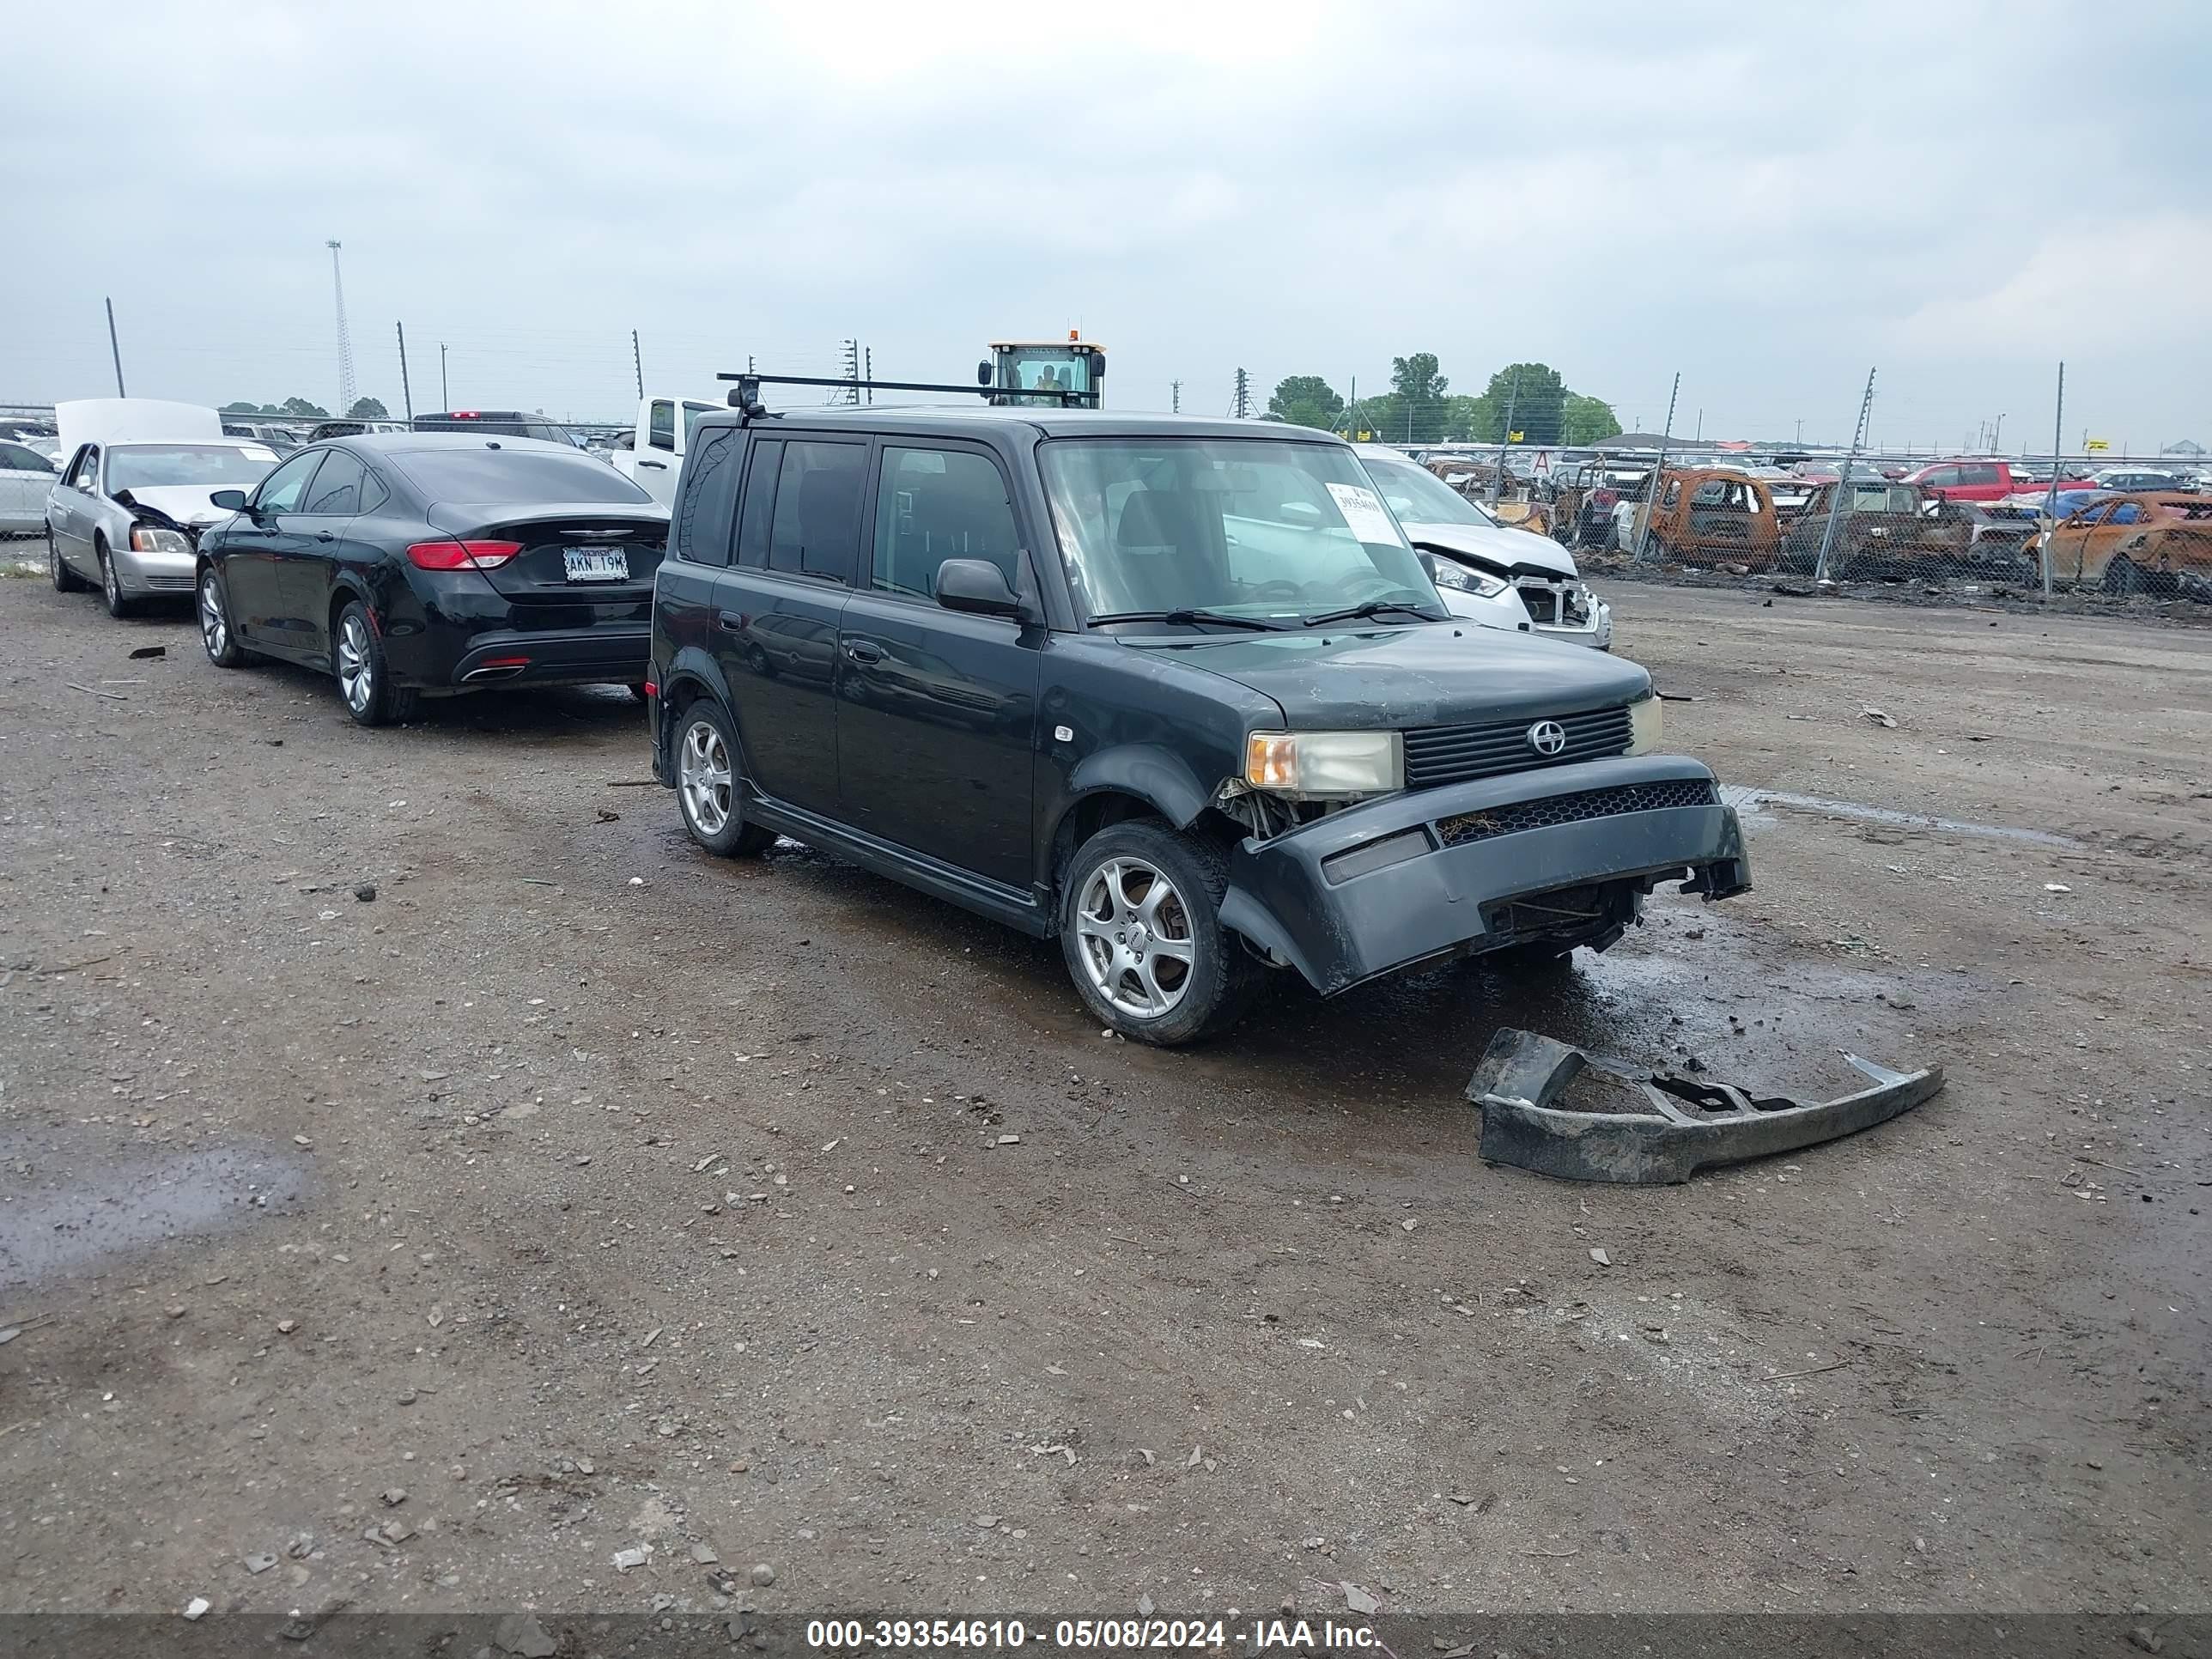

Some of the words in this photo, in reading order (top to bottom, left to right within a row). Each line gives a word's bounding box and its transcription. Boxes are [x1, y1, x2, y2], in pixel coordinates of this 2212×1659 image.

[1533, 452, 1550, 474] A
[570, 556, 593, 572] AKN
[600, 556, 624, 571] 19M
